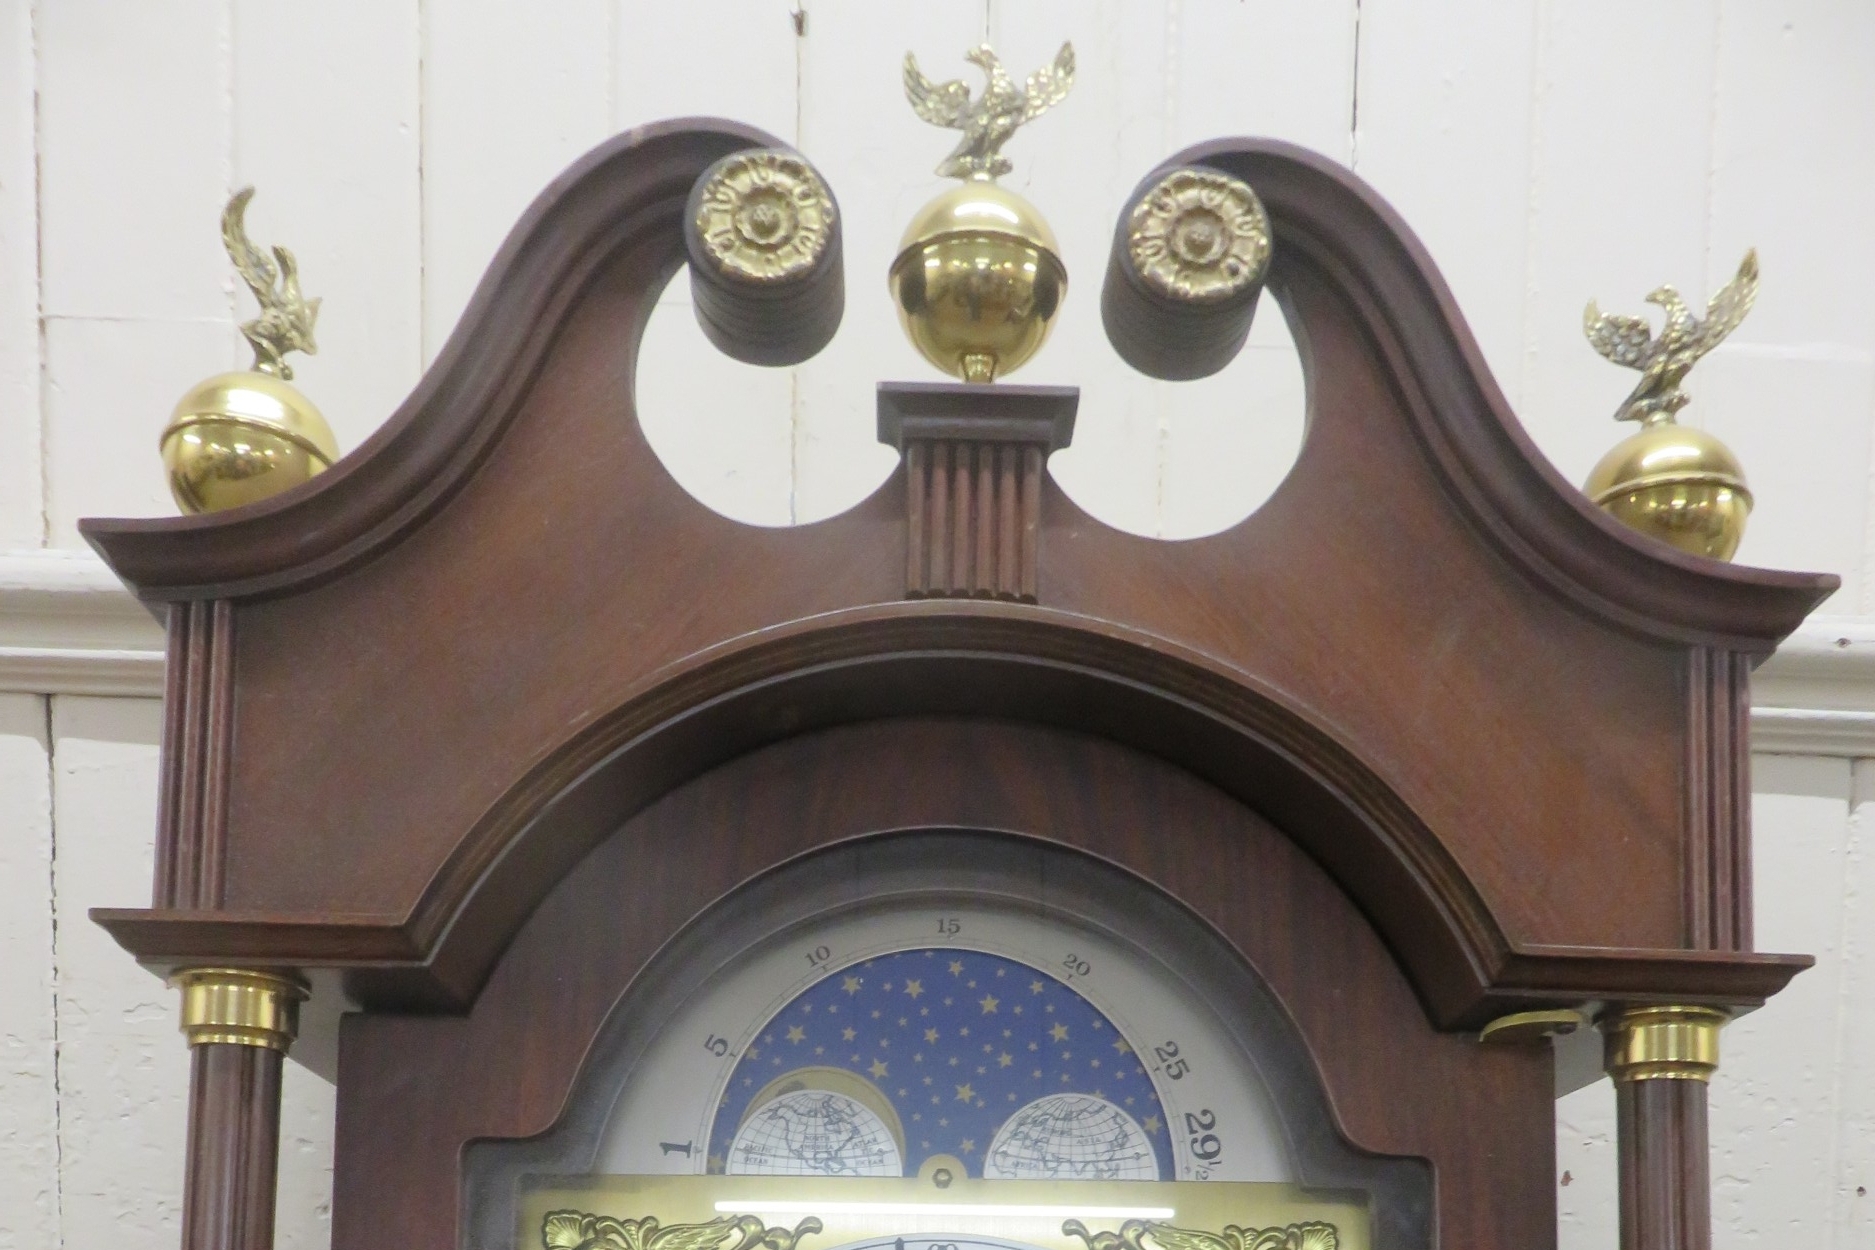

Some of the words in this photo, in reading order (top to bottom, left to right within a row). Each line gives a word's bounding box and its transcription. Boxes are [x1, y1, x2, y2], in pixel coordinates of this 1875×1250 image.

[936, 917, 962, 936] 15
[804, 944, 833, 967] 10
[1064, 952, 1092, 977] 20
[703, 1033, 730, 1058] 5
[1153, 1040, 1190, 1080] 25
[660, 1138, 694, 1159] 1
